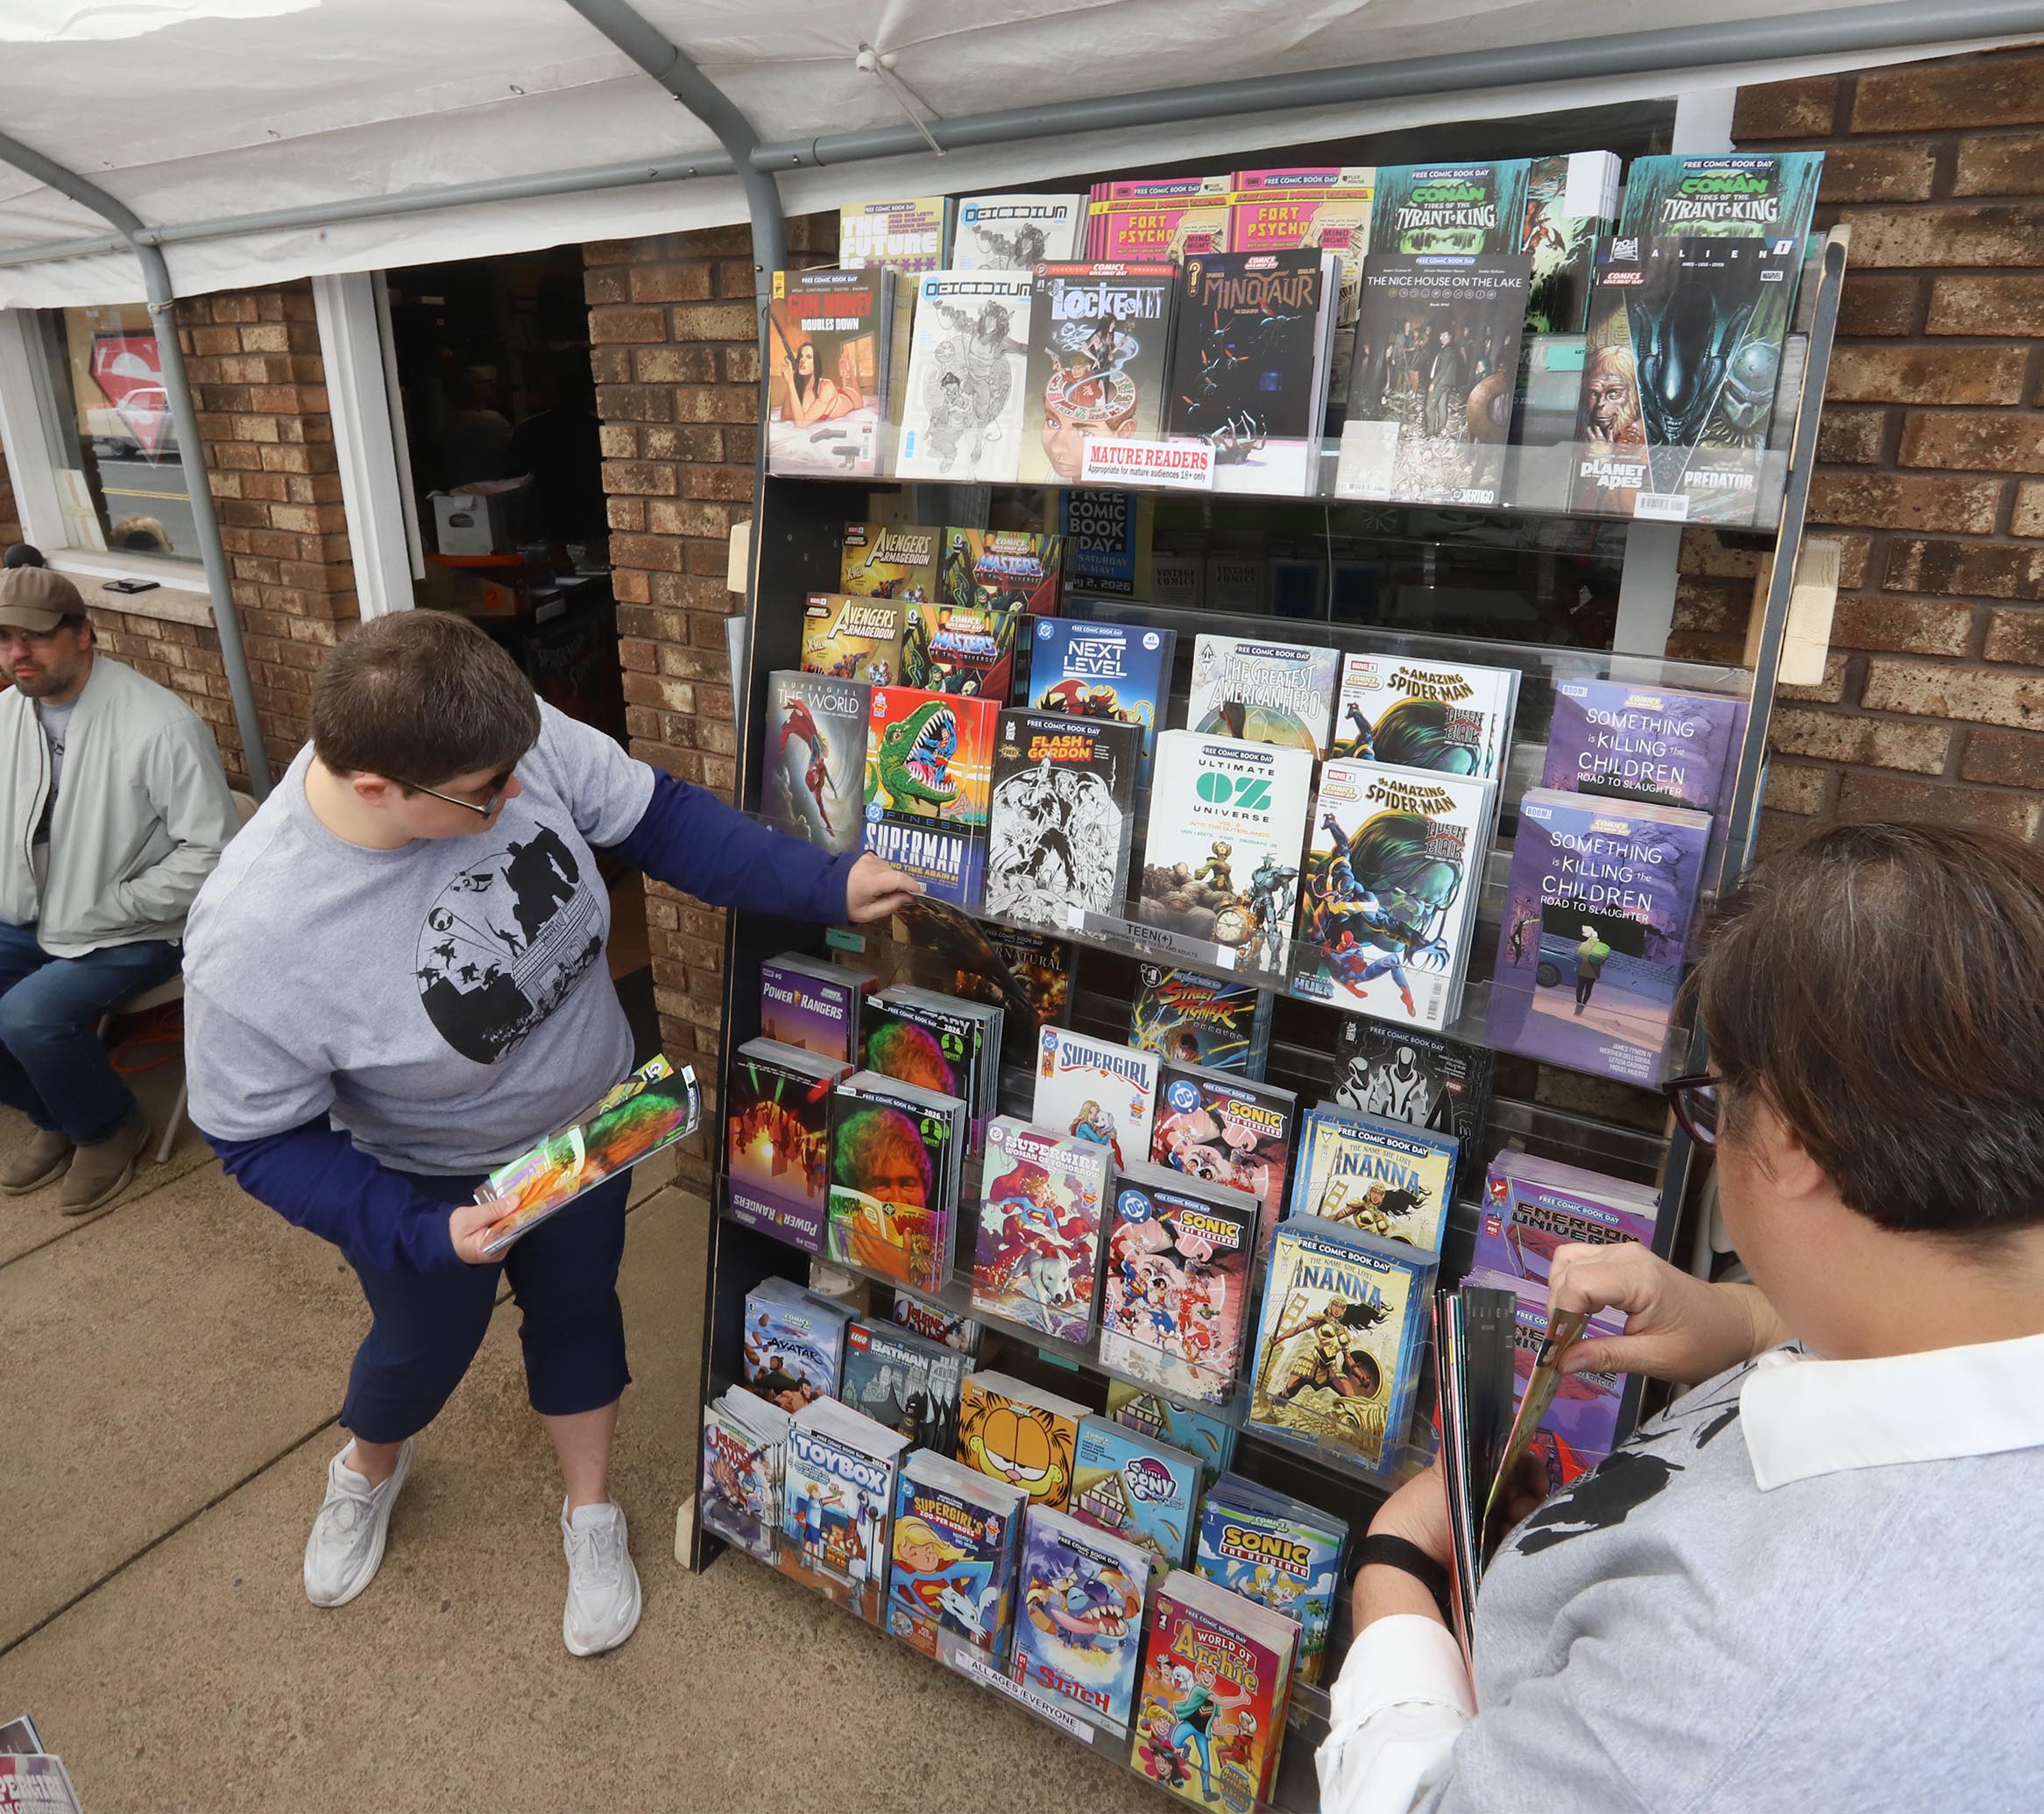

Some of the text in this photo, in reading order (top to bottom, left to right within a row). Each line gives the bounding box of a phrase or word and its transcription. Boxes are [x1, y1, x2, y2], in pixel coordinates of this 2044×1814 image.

[1411, 182, 1486, 202] CONAN
[1681, 176, 1767, 194] CONAN
[1129, 215, 1166, 228] FORT
[1259, 207, 1299, 221] FORT
[840, 233, 937, 256] FUTURE
[1202, 270, 1314, 308] MINOTAUR
[1368, 277, 1522, 287] THE NICE HOUSE ON THE LAKE
[802, 318, 859, 330] DOUBLES DOWN
[1091, 446, 1208, 470] MATURE READERS
[1087, 465, 1121, 475] Appropriate
[1150, 469, 1179, 478] audiences
[1181, 470, 1192, 480] 18+
[1193, 472, 1206, 483] only
[1684, 470, 1754, 491] PREDATOR
[1462, 489, 1494, 504] VERTIGO
[1069, 503, 1125, 519] COMIC
[1070, 519, 1124, 537] BOOK
[1079, 537, 1114, 552] DAY
[976, 555, 1042, 575] MASTERS
[828, 600, 897, 638] AVENGERS
[846, 625, 896, 640] ARMAGEDDON
[930, 631, 997, 656] MASTERS
[1069, 640, 1126, 659] NEXT
[1252, 647, 1275, 656] COMIC
[1276, 650, 1295, 659] BOOK
[1064, 656, 1127, 676] LEVEL
[1224, 653, 1317, 690] THE GREATEST
[809, 694, 859, 713] WORLD
[1208, 675, 1321, 719] AMERICAN HERO
[1044, 722, 1066, 731] COMIC
[1586, 709, 1694, 738] SOMETHING
[1028, 747, 1091, 760] GORDON
[1032, 736, 1082, 748] FLASH
[1597, 732, 1666, 757] KILLING
[1669, 746, 1685, 756] the
[1199, 759, 1275, 776] ULTIMATE
[1578, 752, 1685, 785] CHILDREN
[1196, 772, 1272, 810] OZ
[1387, 780, 1446, 797] AMAZING
[1577, 773, 1682, 796] ROAD TO SLAUGHTER
[887, 812, 964, 831] FINEST
[1193, 806, 1270, 823] UNIVERSE
[865, 822, 962, 874] SUPERMAN
[1550, 832, 1662, 863] SOMETHING
[1562, 856, 1632, 883] KILLING
[1636, 872, 1651, 882] the
[1542, 875, 1652, 912] CHILDREN
[1541, 895, 1649, 924] ROAD TO SLAUGHTER
[1127, 924, 1172, 944] TEEN(+)
[763, 983, 843, 1020] POWER RANGERS
[944, 1024, 960, 1034] 2026
[1369, 1027, 1445, 1051] FREE COMIC BOOK DAY
[1061, 1042, 1150, 1090] SUPERGIRL
[924, 1109, 940, 1119] 2026
[1230, 1103, 1280, 1128] SONIC
[1006, 1136, 1100, 1171] SUPERGIRL
[1338, 1128, 1428, 1155] FREE COMIC BOOK DAY
[1539, 1196, 1619, 1224] FREE COMIC BOOK DAY
[1183, 1213, 1238, 1238] SONIC
[851, 1333, 866, 1344] LEGO
[768, 1337, 821, 1365] AVATAR
[871, 1338, 929, 1371] BATMAN
[797, 1436, 884, 1494] TOYBOX
[1142, 1468, 1161, 1479] LITTLE
[1125, 1471, 1176, 1500] PONY
[914, 1497, 984, 1535] SUPERGIRL'S
[1058, 1536, 1071, 1545] FREE
[1072, 1542, 1090, 1554] COMIC
[1091, 1550, 1107, 1562] BOOK
[1225, 1528, 1310, 1565] SONIC
[1223, 1546, 1307, 1577] THE HEDGEHOG
[1174, 1621, 1258, 1692] Archie
[1198, 1632, 1252, 1662] WORLD OF
[972, 1661, 989, 1676] ALL
[992, 1672, 1018, 1692] AGES
